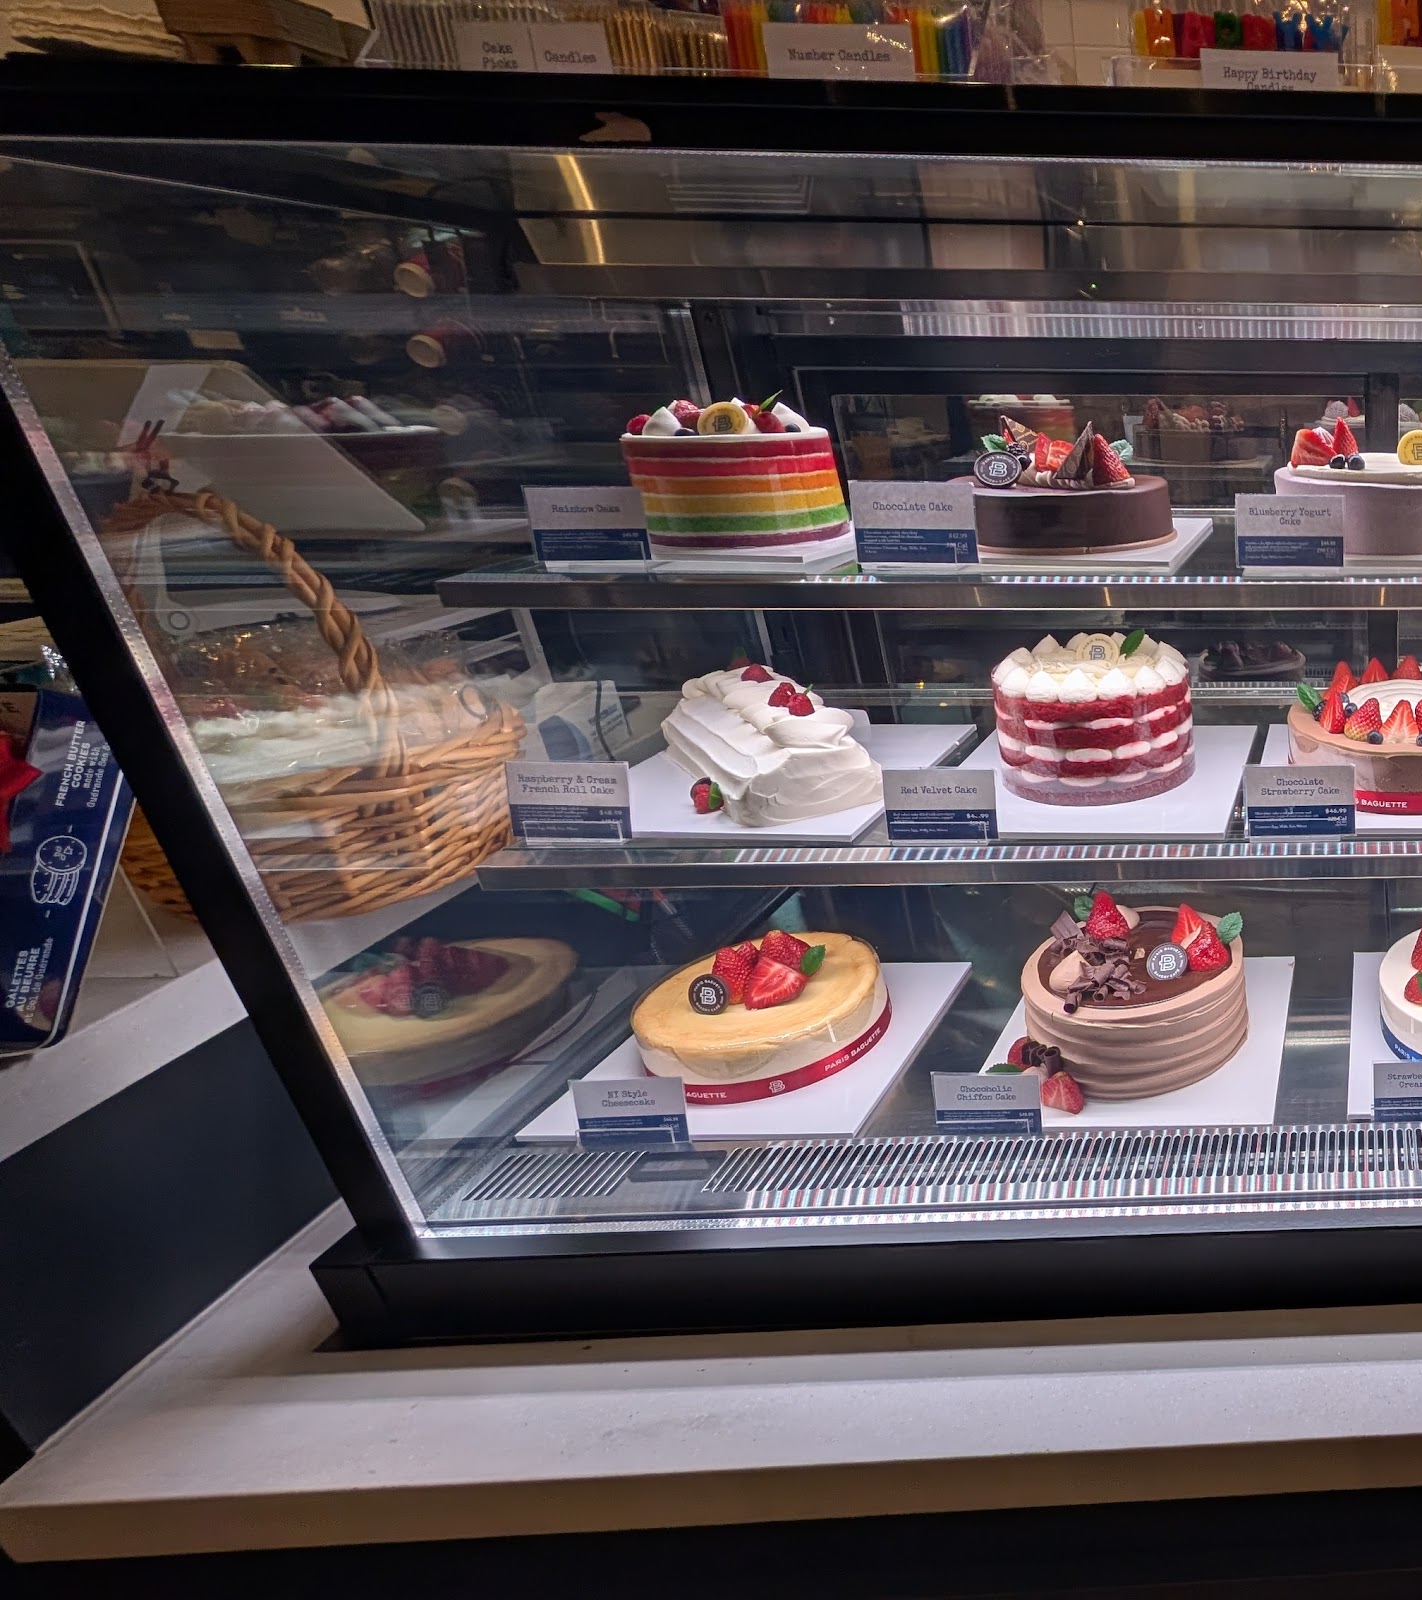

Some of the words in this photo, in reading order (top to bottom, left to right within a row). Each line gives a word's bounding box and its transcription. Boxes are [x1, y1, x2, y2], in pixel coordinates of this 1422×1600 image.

[482, 41, 512, 54] Cake
[544, 51, 596, 63] Candles
[788, 49, 834, 61] Number
[838, 49, 890, 62] Candles
[482, 57, 518, 69] Picks
[1223, 66, 1258, 82] Happy
[1262, 67, 1316, 83] Birthday
[551, 504, 594, 513] Rainbow
[596, 504, 621, 513] Cake
[872, 501, 926, 512] Chocolate
[928, 502, 953, 512] Cake
[1249, 507, 1296, 518] Blueberry
[1298, 507, 1331, 518] Yogurt
[1280, 517, 1301, 526] Cake
[55, 763, 74, 807] FRENCH
[66, 720, 86, 761] BUTTER
[71, 742, 91, 788] COOKIES
[83, 768, 95, 789] made
[89, 746, 100, 767] with
[517, 774, 573, 785] Raspberry
[576, 775, 584, 784] &
[586, 775, 618, 785] Cream
[1276, 777, 1324, 786] Chocolate
[522, 784, 560, 793] French
[563, 785, 587, 794] Roll
[590, 785, 615, 794] Cake
[900, 786, 918, 794] Red
[920, 786, 952, 794] Velvet
[955, 786, 977, 794] Cake
[1261, 787, 1315, 796] Strawberry
[1318, 786, 1340, 795] Cake
[1361, 798, 1408, 809] BAGUETTE
[20, 947, 41, 993] BEURRE
[4, 950, 29, 1009] GALETTES
[15, 996, 27, 1012] AU
[824, 1055, 850, 1072] PARIS
[851, 1026, 882, 1057] BAGUETTE
[1394, 1043, 1412, 1061] PARIS
[608, 1090, 619, 1099] NY
[621, 1089, 648, 1099] Style
[960, 1085, 1012, 1093] Chocoholic
[602, 1098, 655, 1107] Cheesecake
[957, 1093, 993, 1101] Chiffon
[995, 1093, 1017, 1101] Cake
